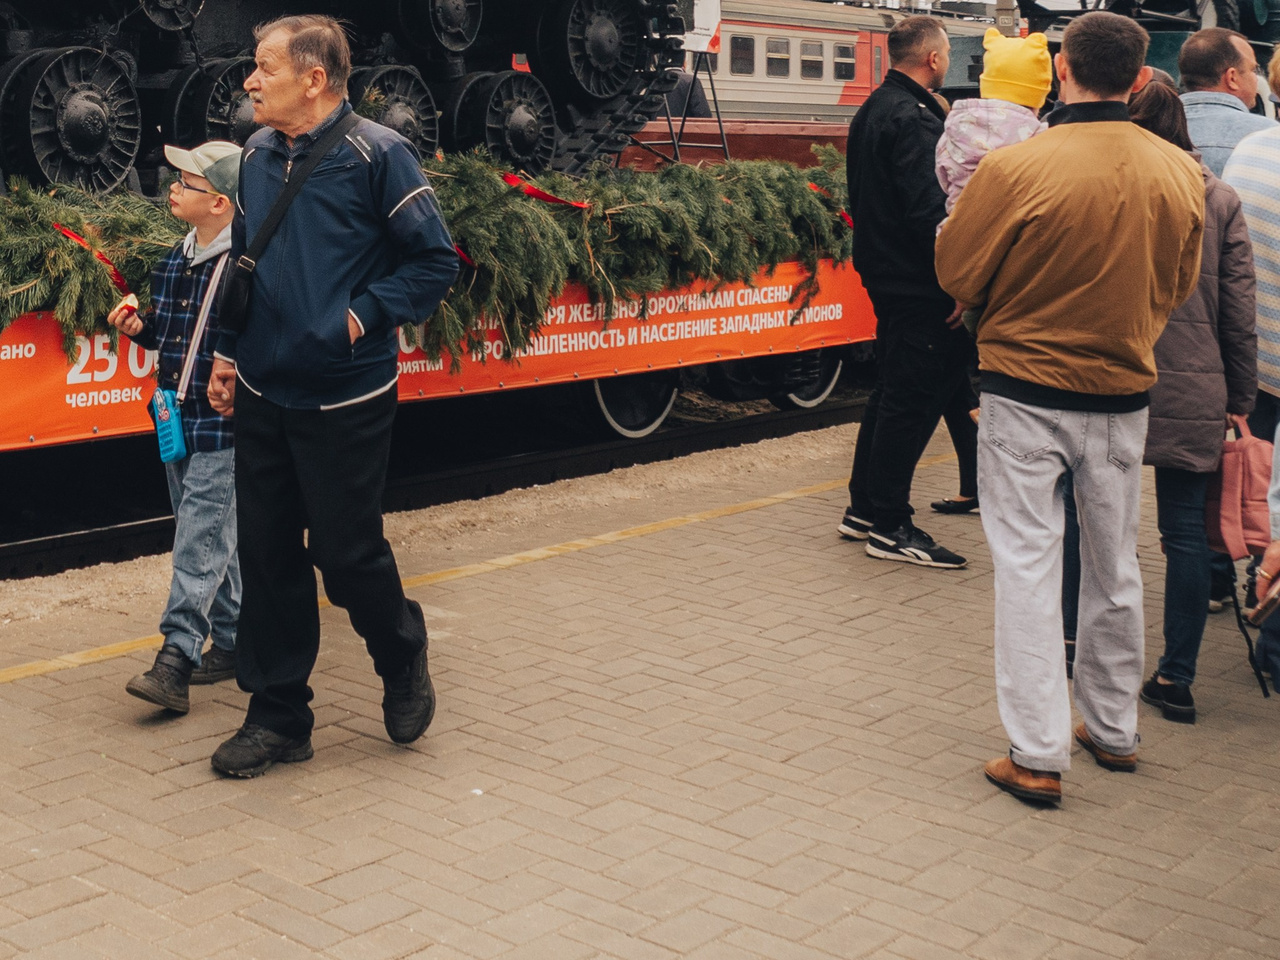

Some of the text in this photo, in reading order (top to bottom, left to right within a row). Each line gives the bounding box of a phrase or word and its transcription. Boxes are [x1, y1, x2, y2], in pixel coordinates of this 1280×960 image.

[737, 284, 793, 306] СПАСЕНЫ
[472, 328, 625, 362] ПРОЫШЛЕННОСТЬ
[628, 326, 638, 346] И
[641, 318, 717, 344] НАСЕЛЕНИЕ
[719, 309, 785, 335] ЗАПАДНЫХ
[66, 334, 118, 385] 25
[65, 386, 142, 408] человек
